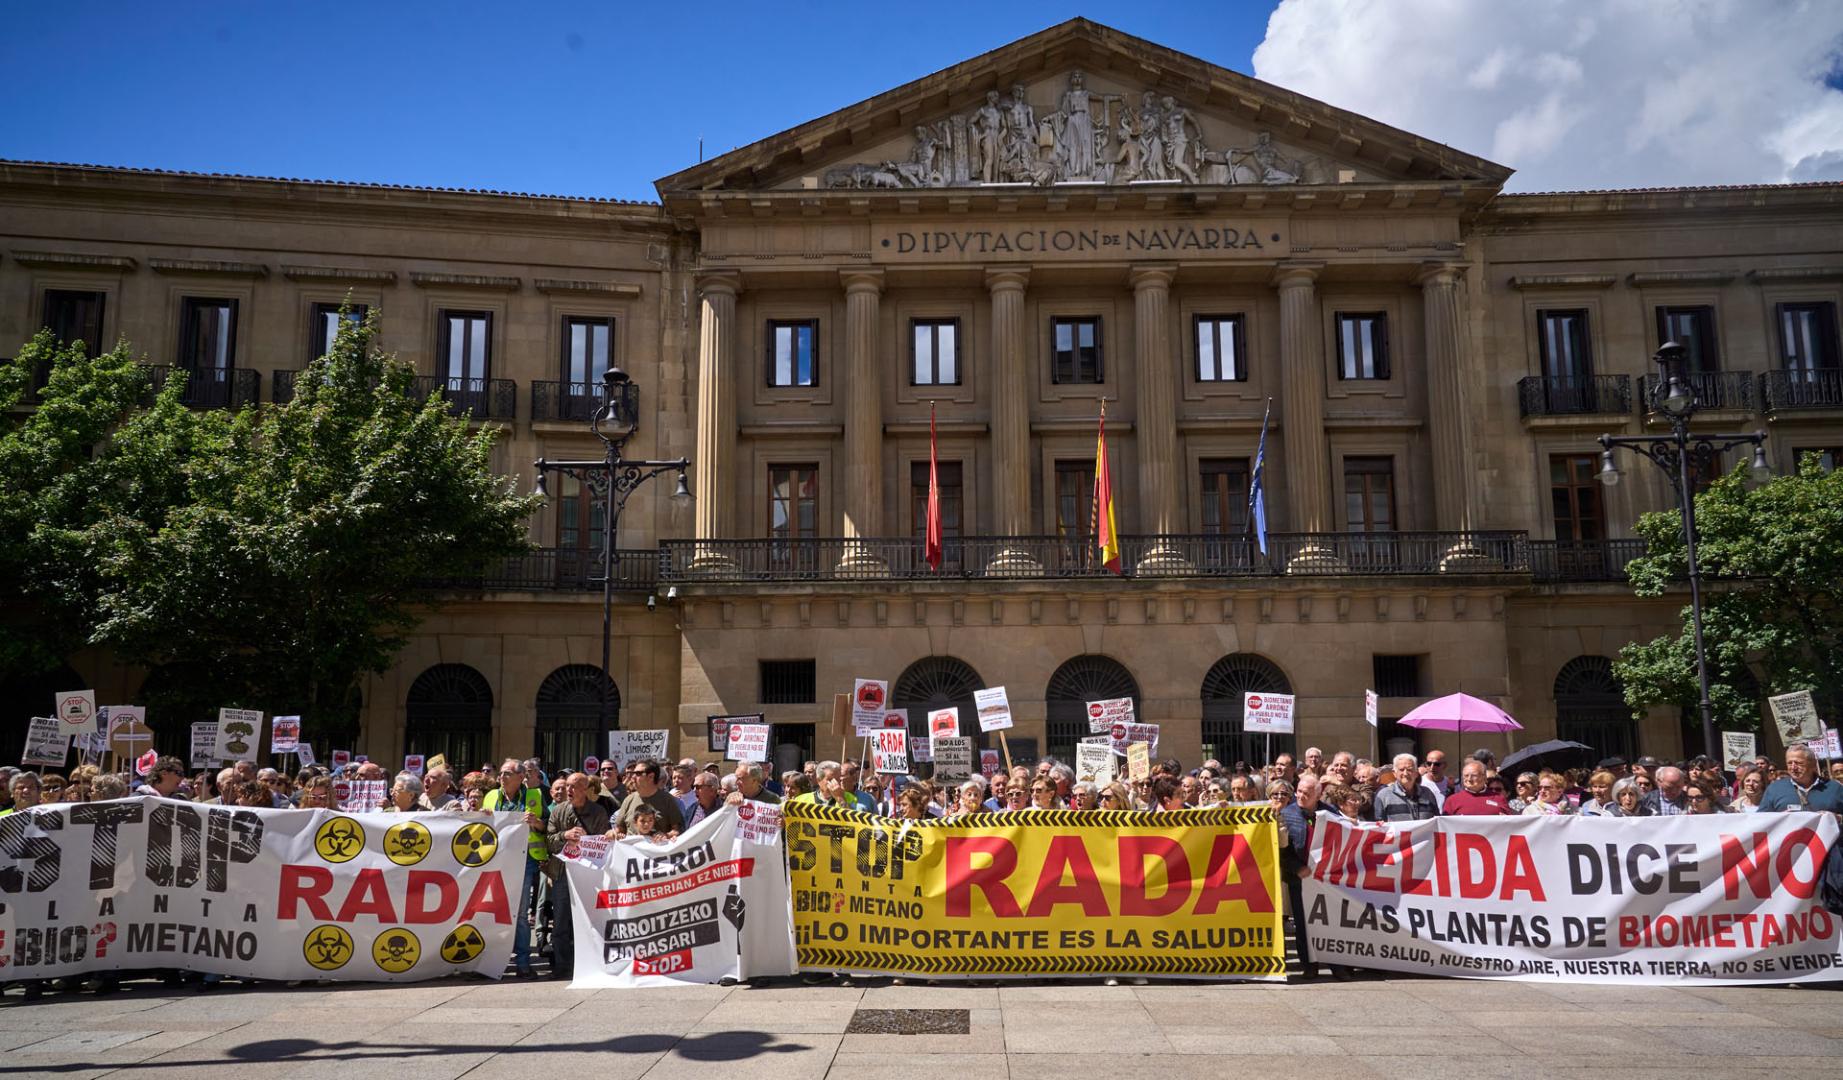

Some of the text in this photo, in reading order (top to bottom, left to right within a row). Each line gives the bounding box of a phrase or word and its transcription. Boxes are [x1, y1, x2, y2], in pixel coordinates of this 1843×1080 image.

[1102, 234, 1121, 246] DE
[1126, 228, 1264, 251] NAVARRA
[1089, 707, 1104, 715] STOP
[1264, 696, 1292, 704] BIOMETANO
[627, 731, 664, 742] PUEBLOS
[655, 744, 661, 752] Y
[880, 732, 905, 753] RADA
[874, 754, 883, 769] NO
[738, 806, 755, 817] STOP
[769, 826, 777, 835] SE
[0, 803, 264, 893] STOP
[588, 850, 597, 859] NO
[786, 821, 924, 881] STOP
[1312, 819, 1829, 903] MELIDA DICE NO
[608, 892, 618, 905] EZ
[618, 890, 640, 903] ZURE
[642, 878, 696, 900] HERRIAN,
[697, 871, 711, 884] EZ
[945, 833, 1276, 918] RADA
[277, 864, 513, 926] RADA
[849, 895, 924, 921] METANO
[609, 901, 713, 940] ARROITZEKO
[1307, 893, 1834, 949] A LAS PLANTAS DE BIOMETANO
[127, 922, 259, 962] METANO
[859, 923, 1049, 950] IMPORTANTE
[1059, 929, 1095, 949] ES
[1105, 929, 1142, 949] LA
[1152, 926, 1273, 950] SALUD!!!
[637, 954, 686, 974] STOP.
[1379, 942, 1435, 968] SALUD,
[1439, 953, 1515, 973] NUESTRO
[1518, 959, 1561, 977] AIRE,
[1564, 959, 1643, 977] NUESTRA
[1647, 960, 1717, 979] TIERRA,
[1722, 959, 1747, 975] NO
[1752, 958, 1775, 973] SE
[1776, 951, 1843, 971] VENDE
